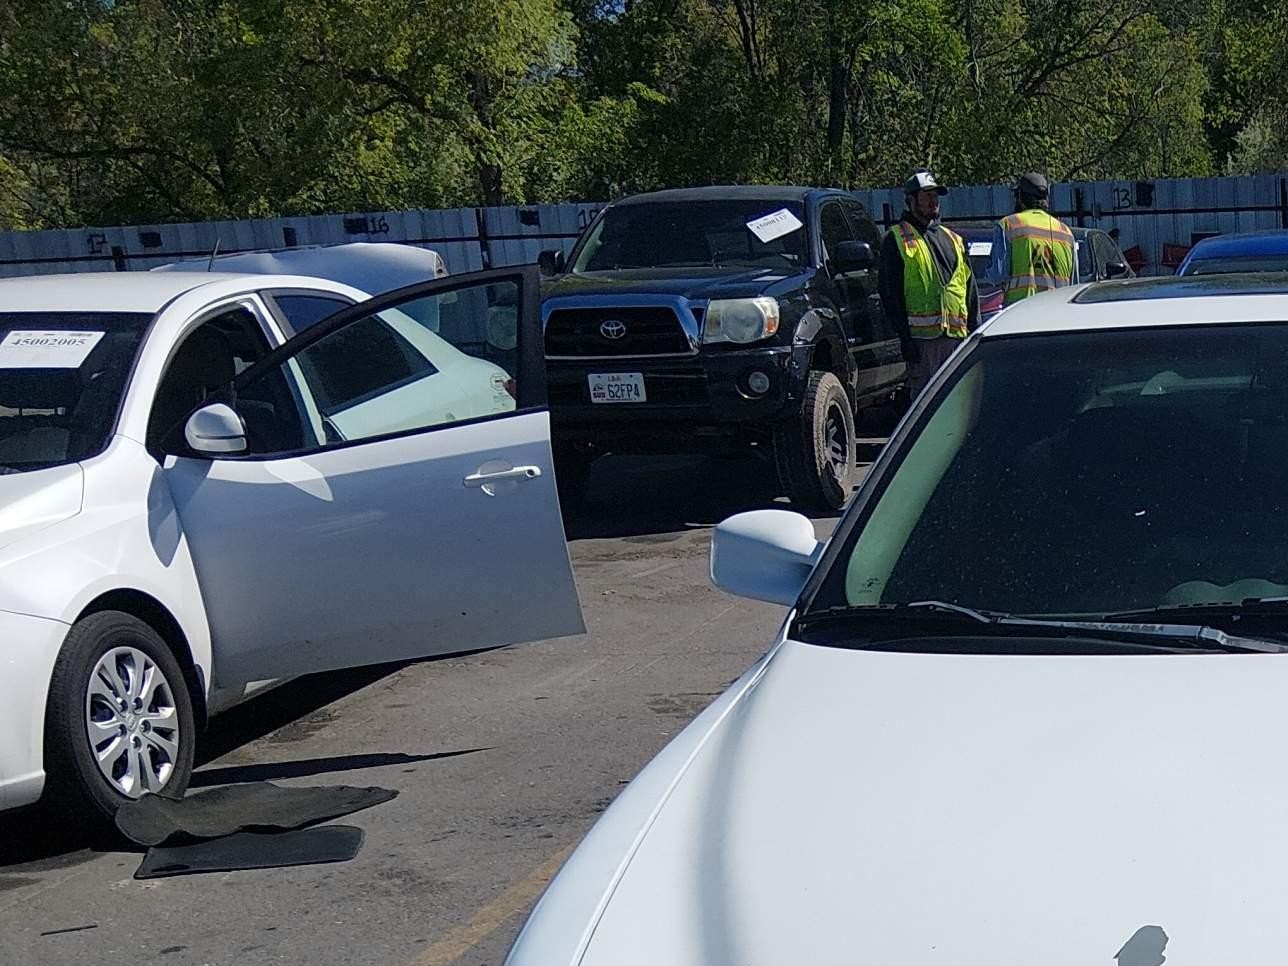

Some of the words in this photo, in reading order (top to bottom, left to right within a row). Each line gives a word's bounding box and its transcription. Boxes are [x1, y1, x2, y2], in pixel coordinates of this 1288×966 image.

[1113, 187, 1131, 209] 13
[370, 216, 390, 234] 16
[607, 383, 641, 399] 62FP4
